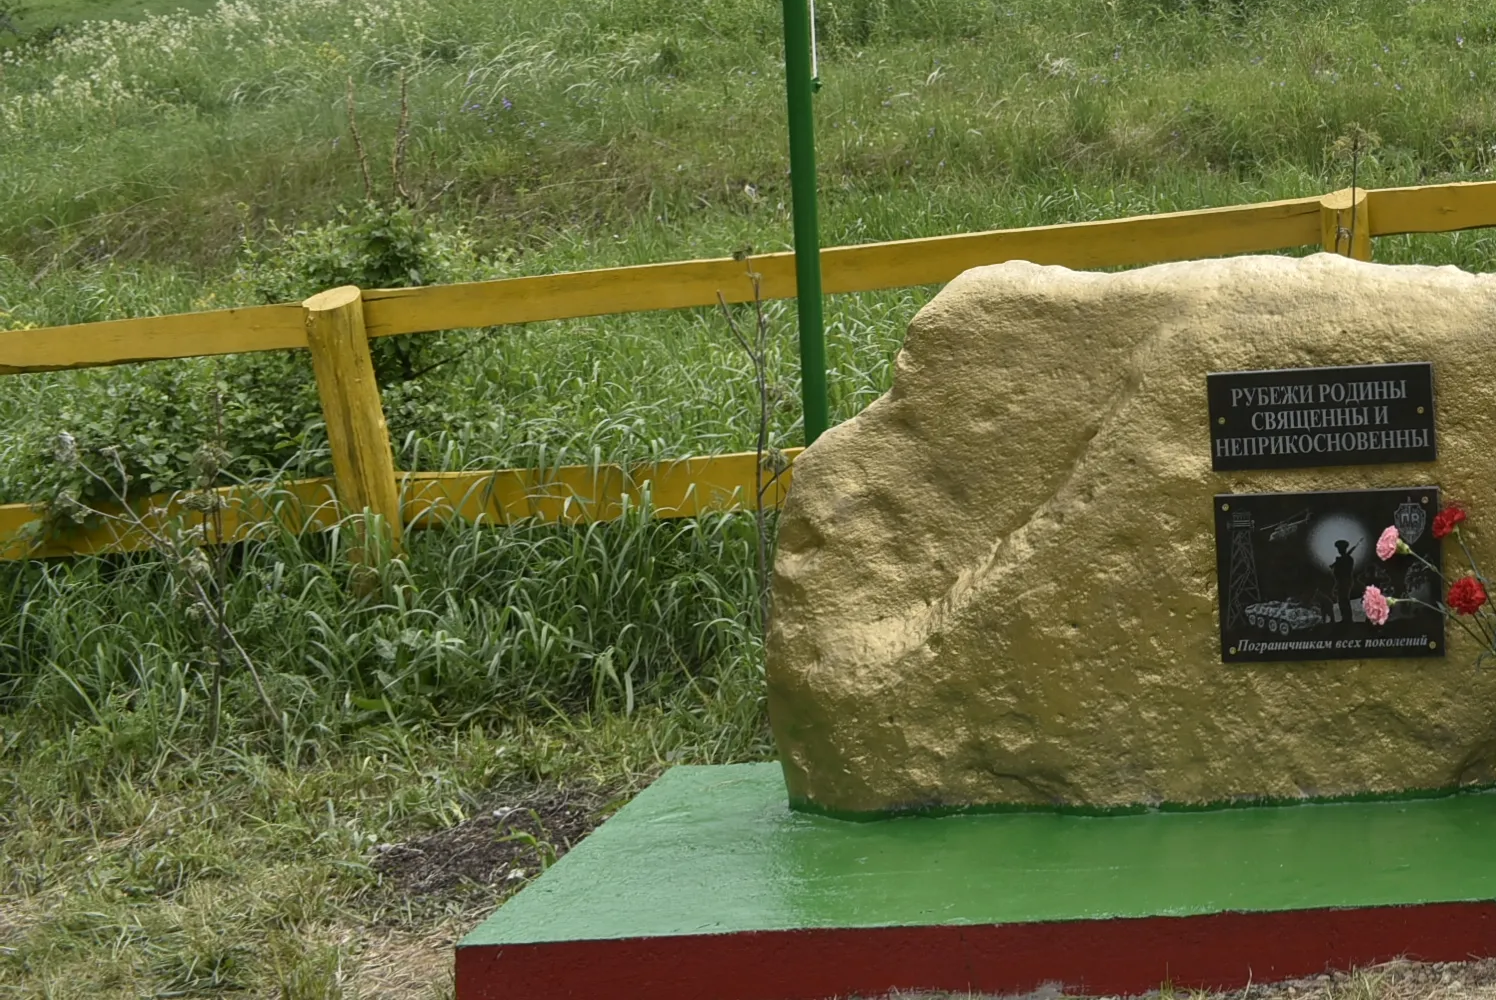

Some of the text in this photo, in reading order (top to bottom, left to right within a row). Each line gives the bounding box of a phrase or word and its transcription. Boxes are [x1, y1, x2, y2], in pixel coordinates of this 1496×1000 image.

[1230, 380, 1407, 407] РУБЕЖИ РОДИНЫ
[1251, 405, 1389, 431] СВЯЩЕННЫ И
[1215, 428, 1430, 457] НЕПРИКОСНОВЕННЫ
[1237, 633, 1428, 653] Пограничникам всех поколений
